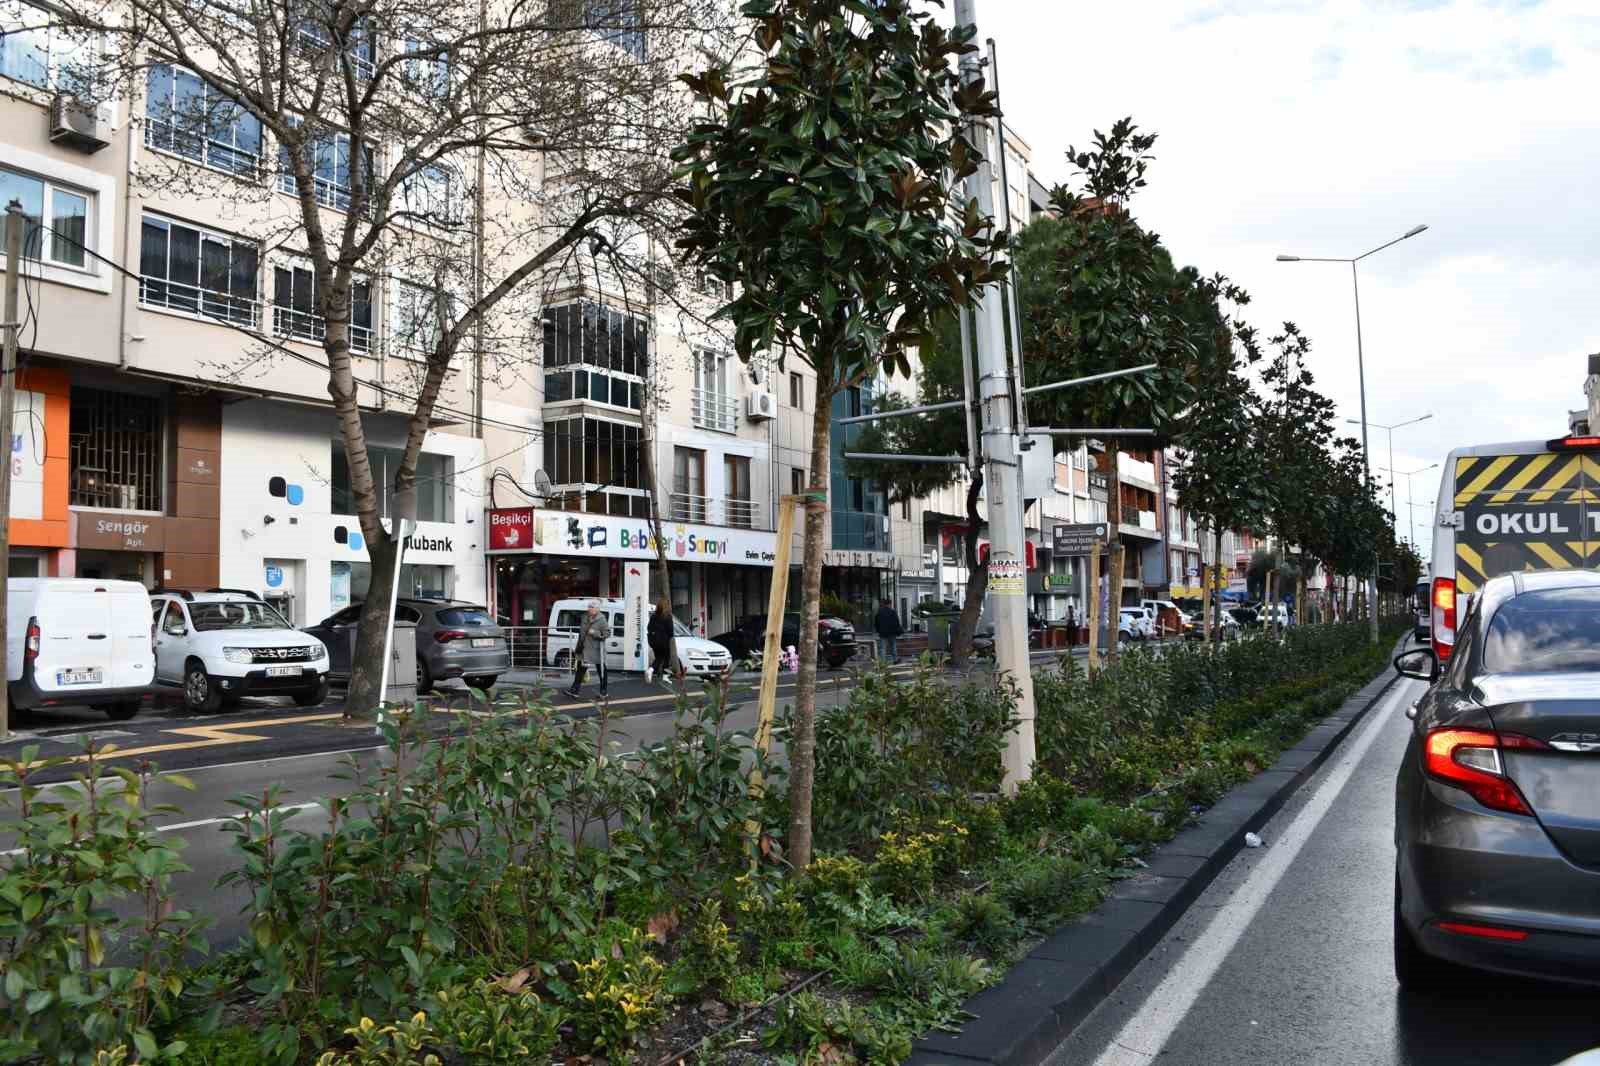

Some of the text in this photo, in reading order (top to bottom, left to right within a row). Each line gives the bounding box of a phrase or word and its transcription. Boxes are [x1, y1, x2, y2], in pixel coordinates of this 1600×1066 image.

[97, 520, 149, 535] Şengör
[491, 513, 531, 526] Beşikçi
[1476, 511, 1600, 534] OKUL T
[620, 528, 672, 552] Bebeer
